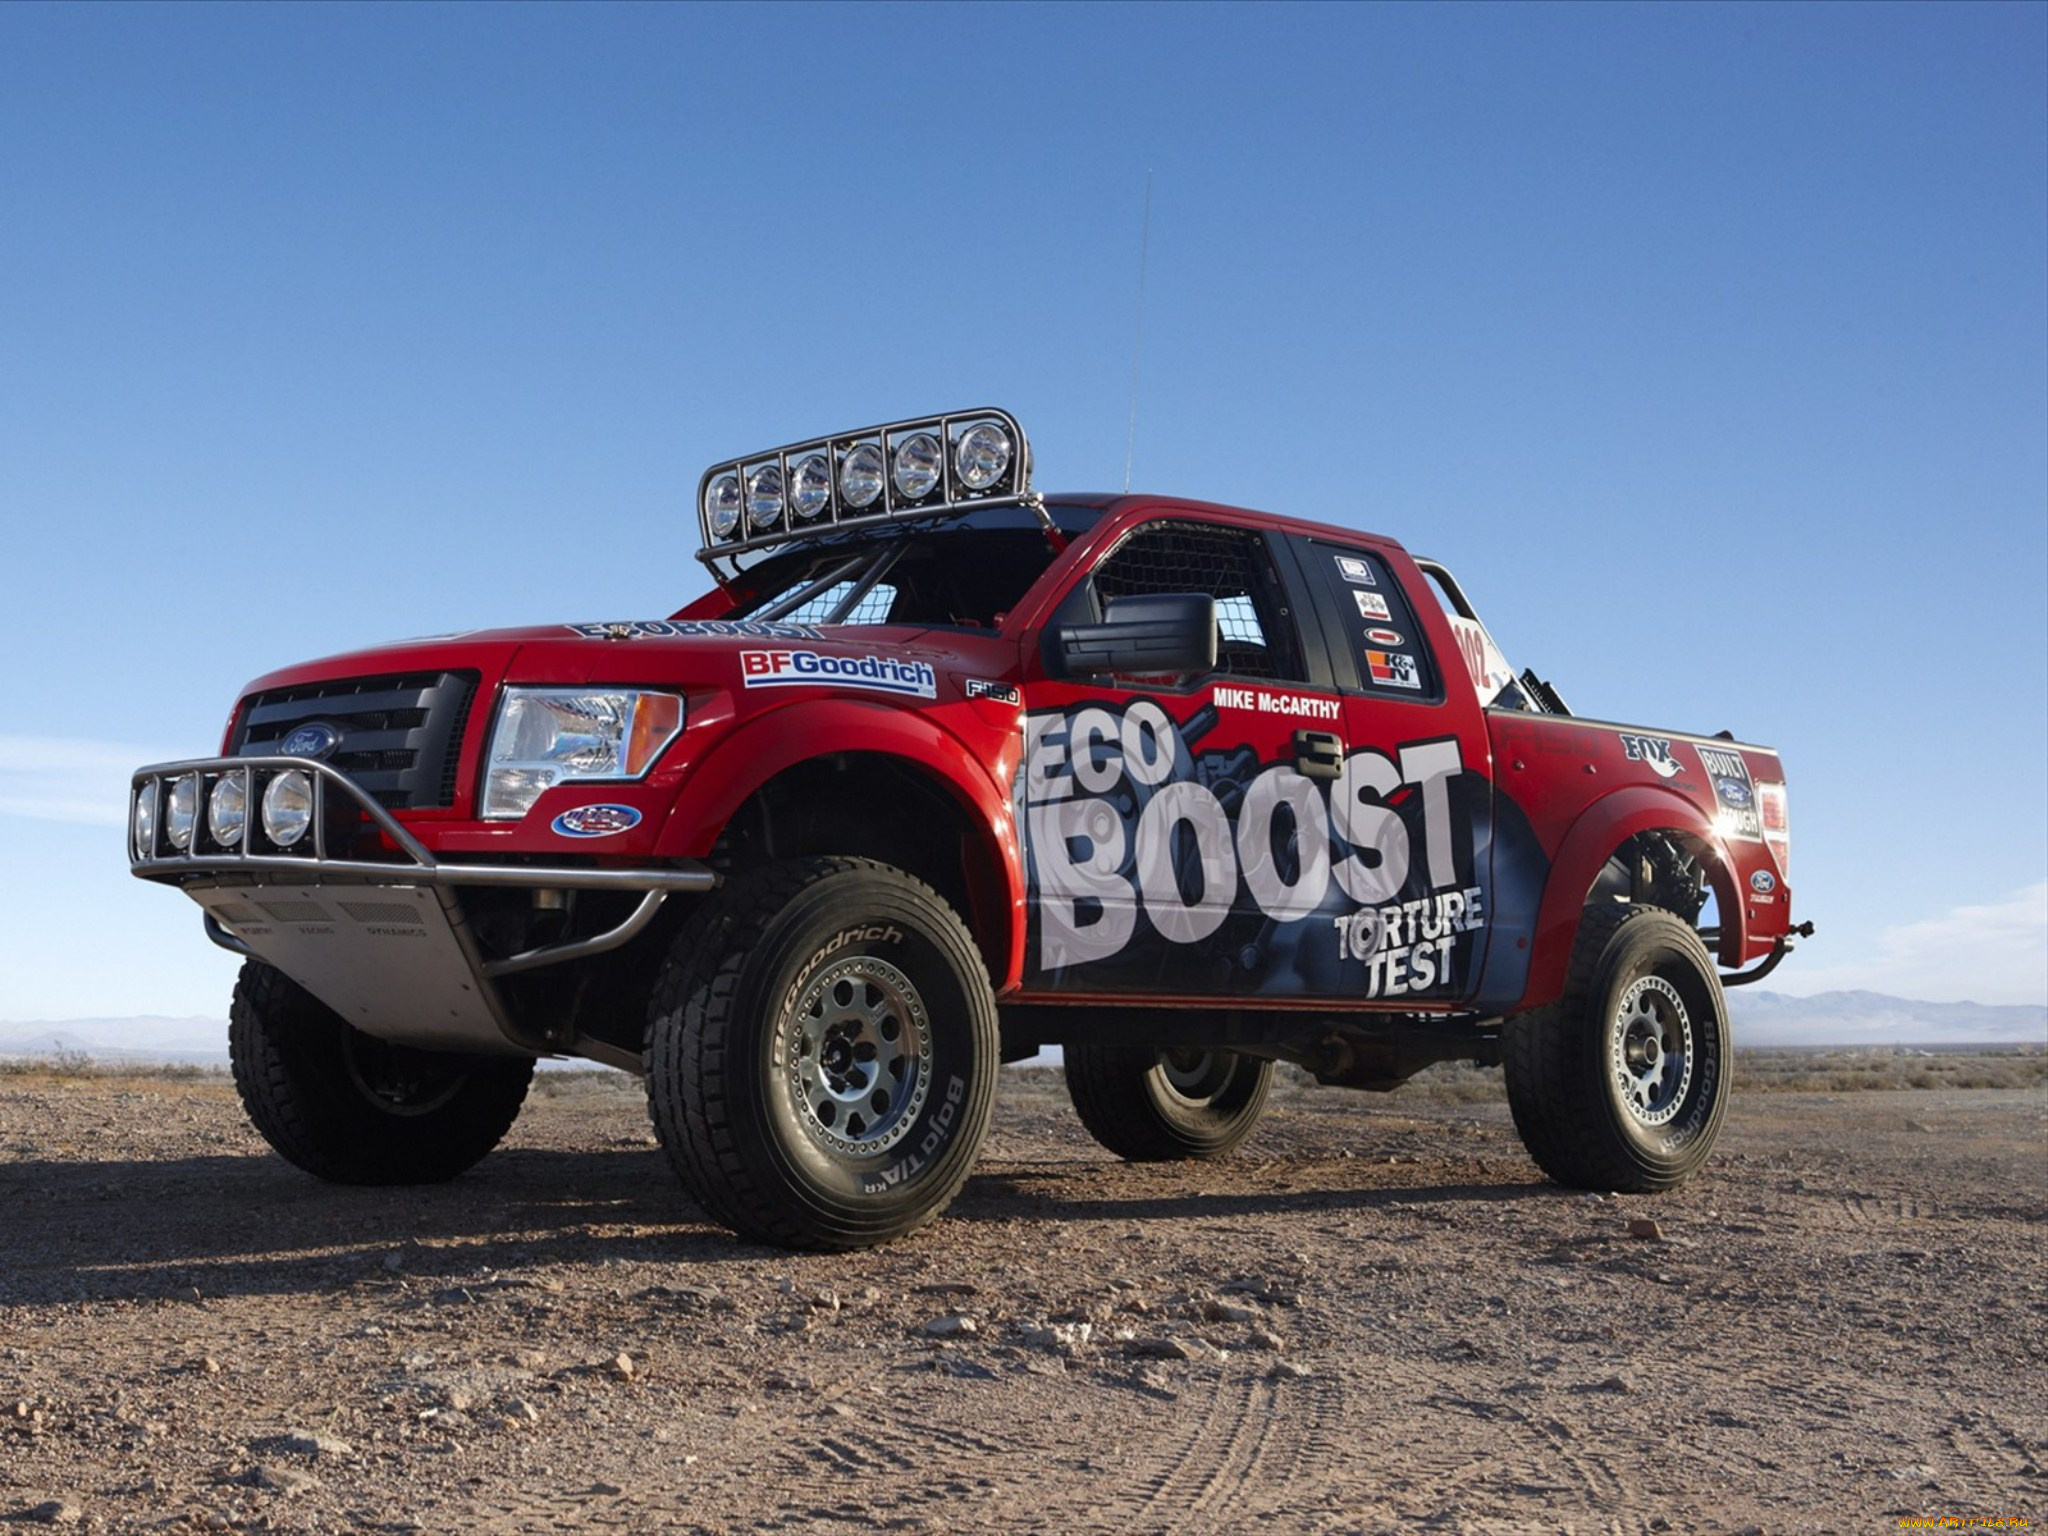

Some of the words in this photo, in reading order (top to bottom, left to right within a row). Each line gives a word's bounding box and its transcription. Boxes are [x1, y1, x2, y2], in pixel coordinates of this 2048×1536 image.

[742, 652, 934, 686] BFGoodrich
[1214, 687, 1254, 710] MIKE
[1258, 692, 1340, 719] McCARTHY
[290, 732, 320, 753] Ford
[1027, 701, 1175, 802] ECO
[1619, 733, 1672, 764] FOX
[1701, 750, 1746, 779] BUILT
[1029, 740, 1463, 972] BOOST
[1334, 887, 1484, 960] TORTURE
[1364, 935, 1456, 999] TEST
[773, 924, 904, 1066] BFGoodrich
[1662, 1021, 1717, 1151] BFGoodrich
[920, 1074, 965, 1156] Baja
[864, 1181, 888, 1194] KR
[880, 1153, 926, 1186] T/A
